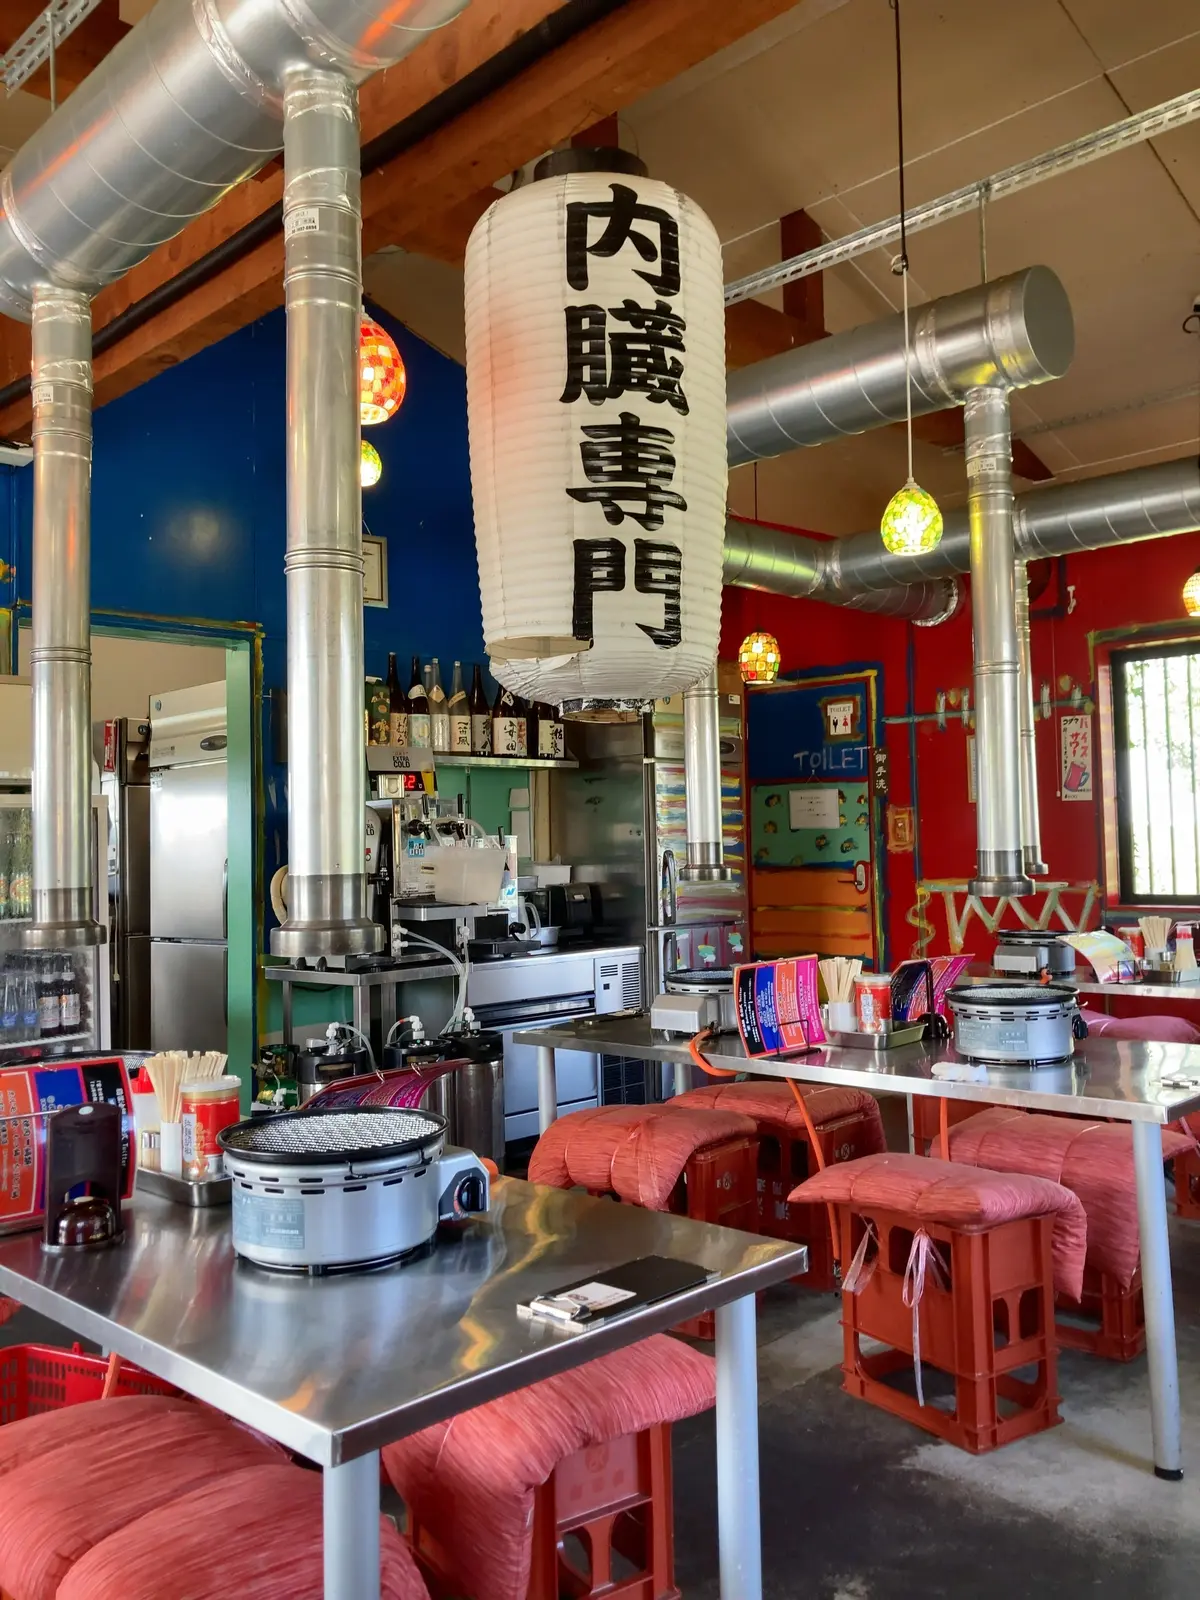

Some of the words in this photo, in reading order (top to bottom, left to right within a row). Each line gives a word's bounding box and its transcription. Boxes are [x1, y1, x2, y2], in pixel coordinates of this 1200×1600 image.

[559, 183, 689, 650] 内臓専門
[393, 760, 411, 768] COLD
[793, 746, 871, 771] TOILET
[876, 753, 887, 789] 御手洗
